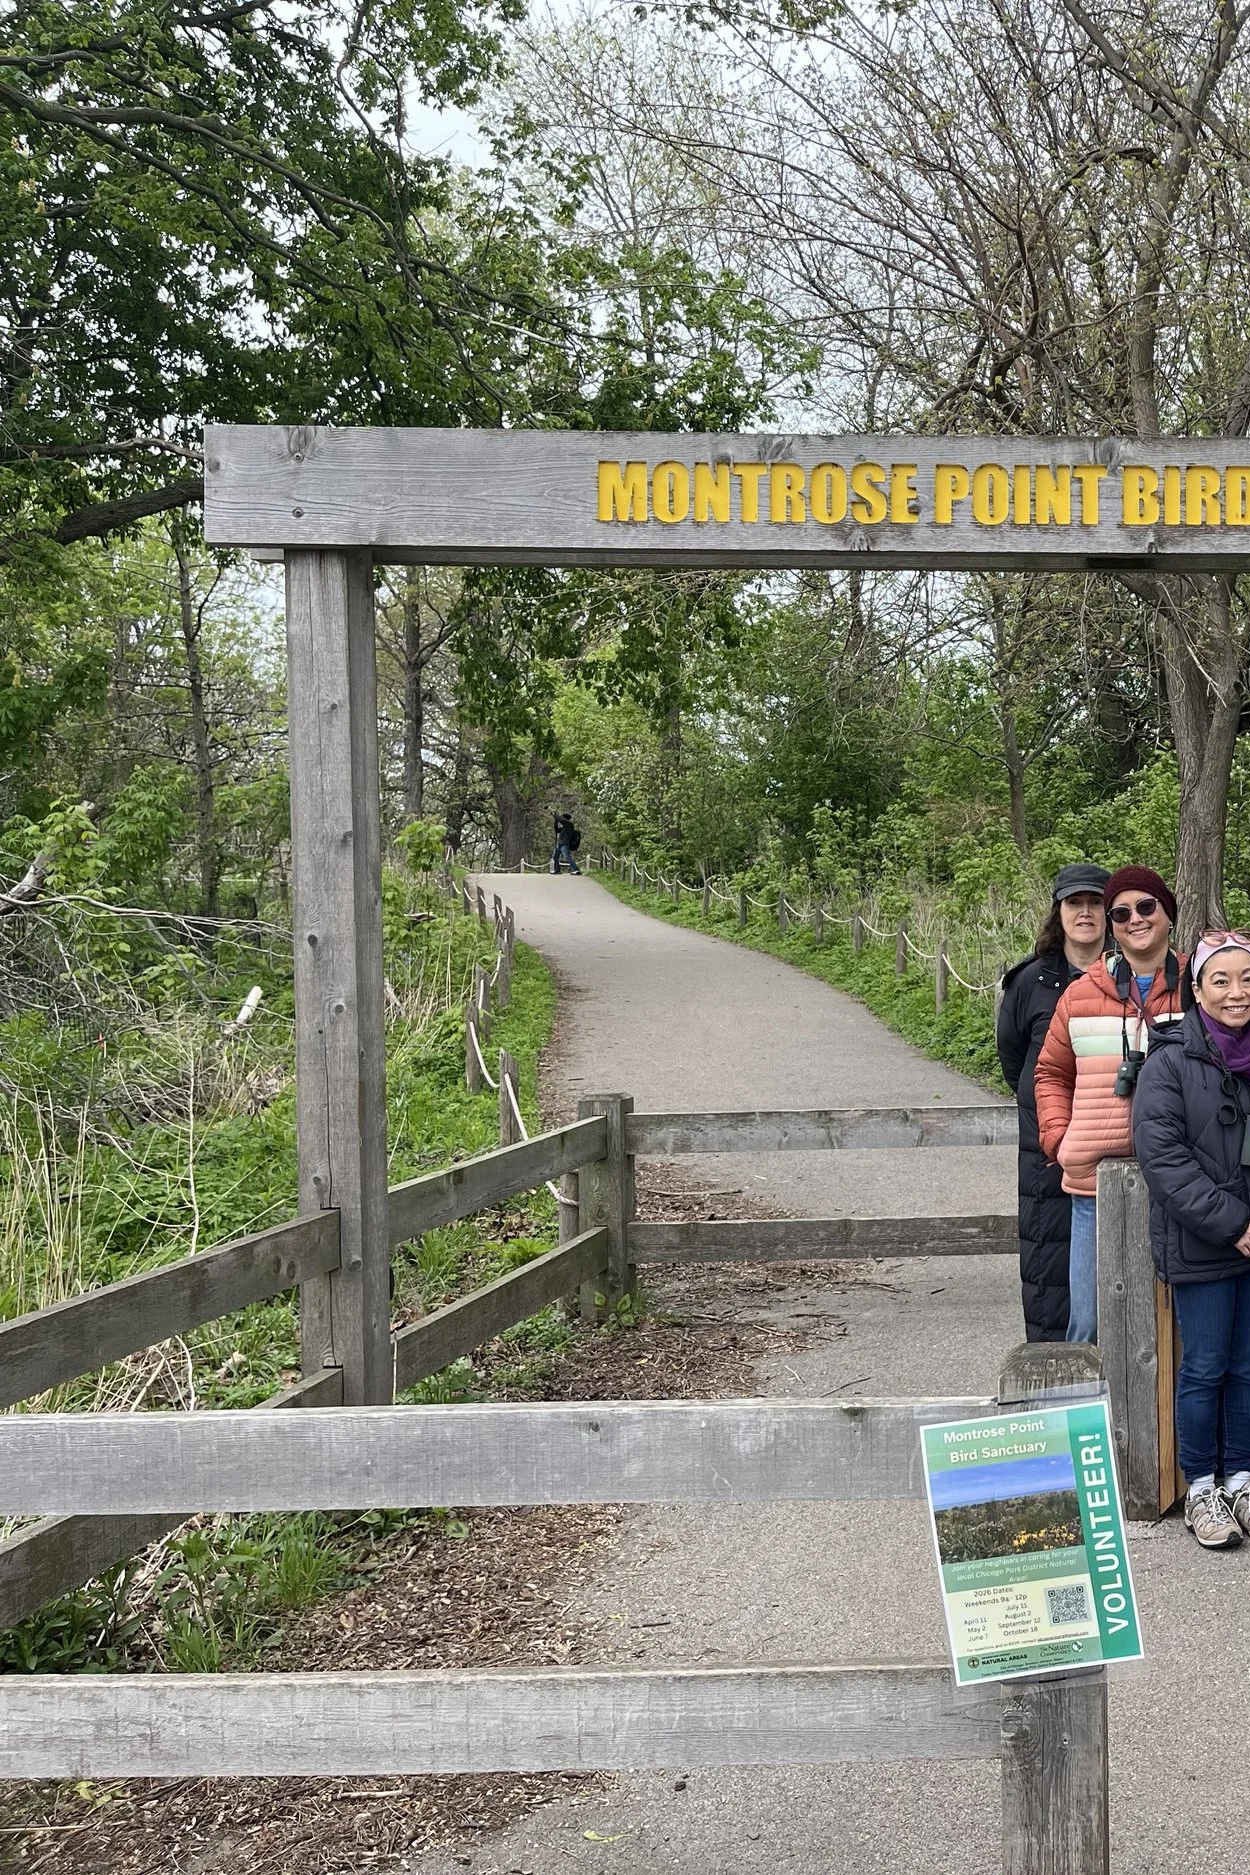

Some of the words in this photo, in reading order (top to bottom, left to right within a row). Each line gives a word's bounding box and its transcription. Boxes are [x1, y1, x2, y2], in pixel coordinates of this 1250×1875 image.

[598, 460, 919, 525] MONTROSE
[935, 464, 1108, 526] POINT
[944, 1427, 1006, 1444] Montrose
[1010, 1420, 1045, 1434] Point
[950, 1449, 978, 1463] Bird
[981, 1442, 1047, 1459] Sanctuary
[1079, 1434, 1129, 1635] VOLUNTEER!
[952, 1565, 966, 1573] Join
[967, 1563, 984, 1572] your
[985, 1558, 1019, 1568] neighbors
[1028, 1553, 1050, 1561] caring
[1063, 1549, 1079, 1558] your
[957, 1573, 974, 1581] local
[976, 1569, 1004, 1578] Chicago
[1005, 1566, 1021, 1574] Park
[1023, 1563, 1048, 1572] District
[1049, 1558, 1076, 1567] Natural
[1009, 1575, 1028, 1583] Area!
[974, 1590, 992, 1598] 2026
[965, 1598, 1000, 1608] Weekends
[1005, 1612, 1027, 1620] August
[964, 1618, 979, 1626] April
[998, 1620, 1032, 1629] September
[1004, 1628, 1029, 1637] October
